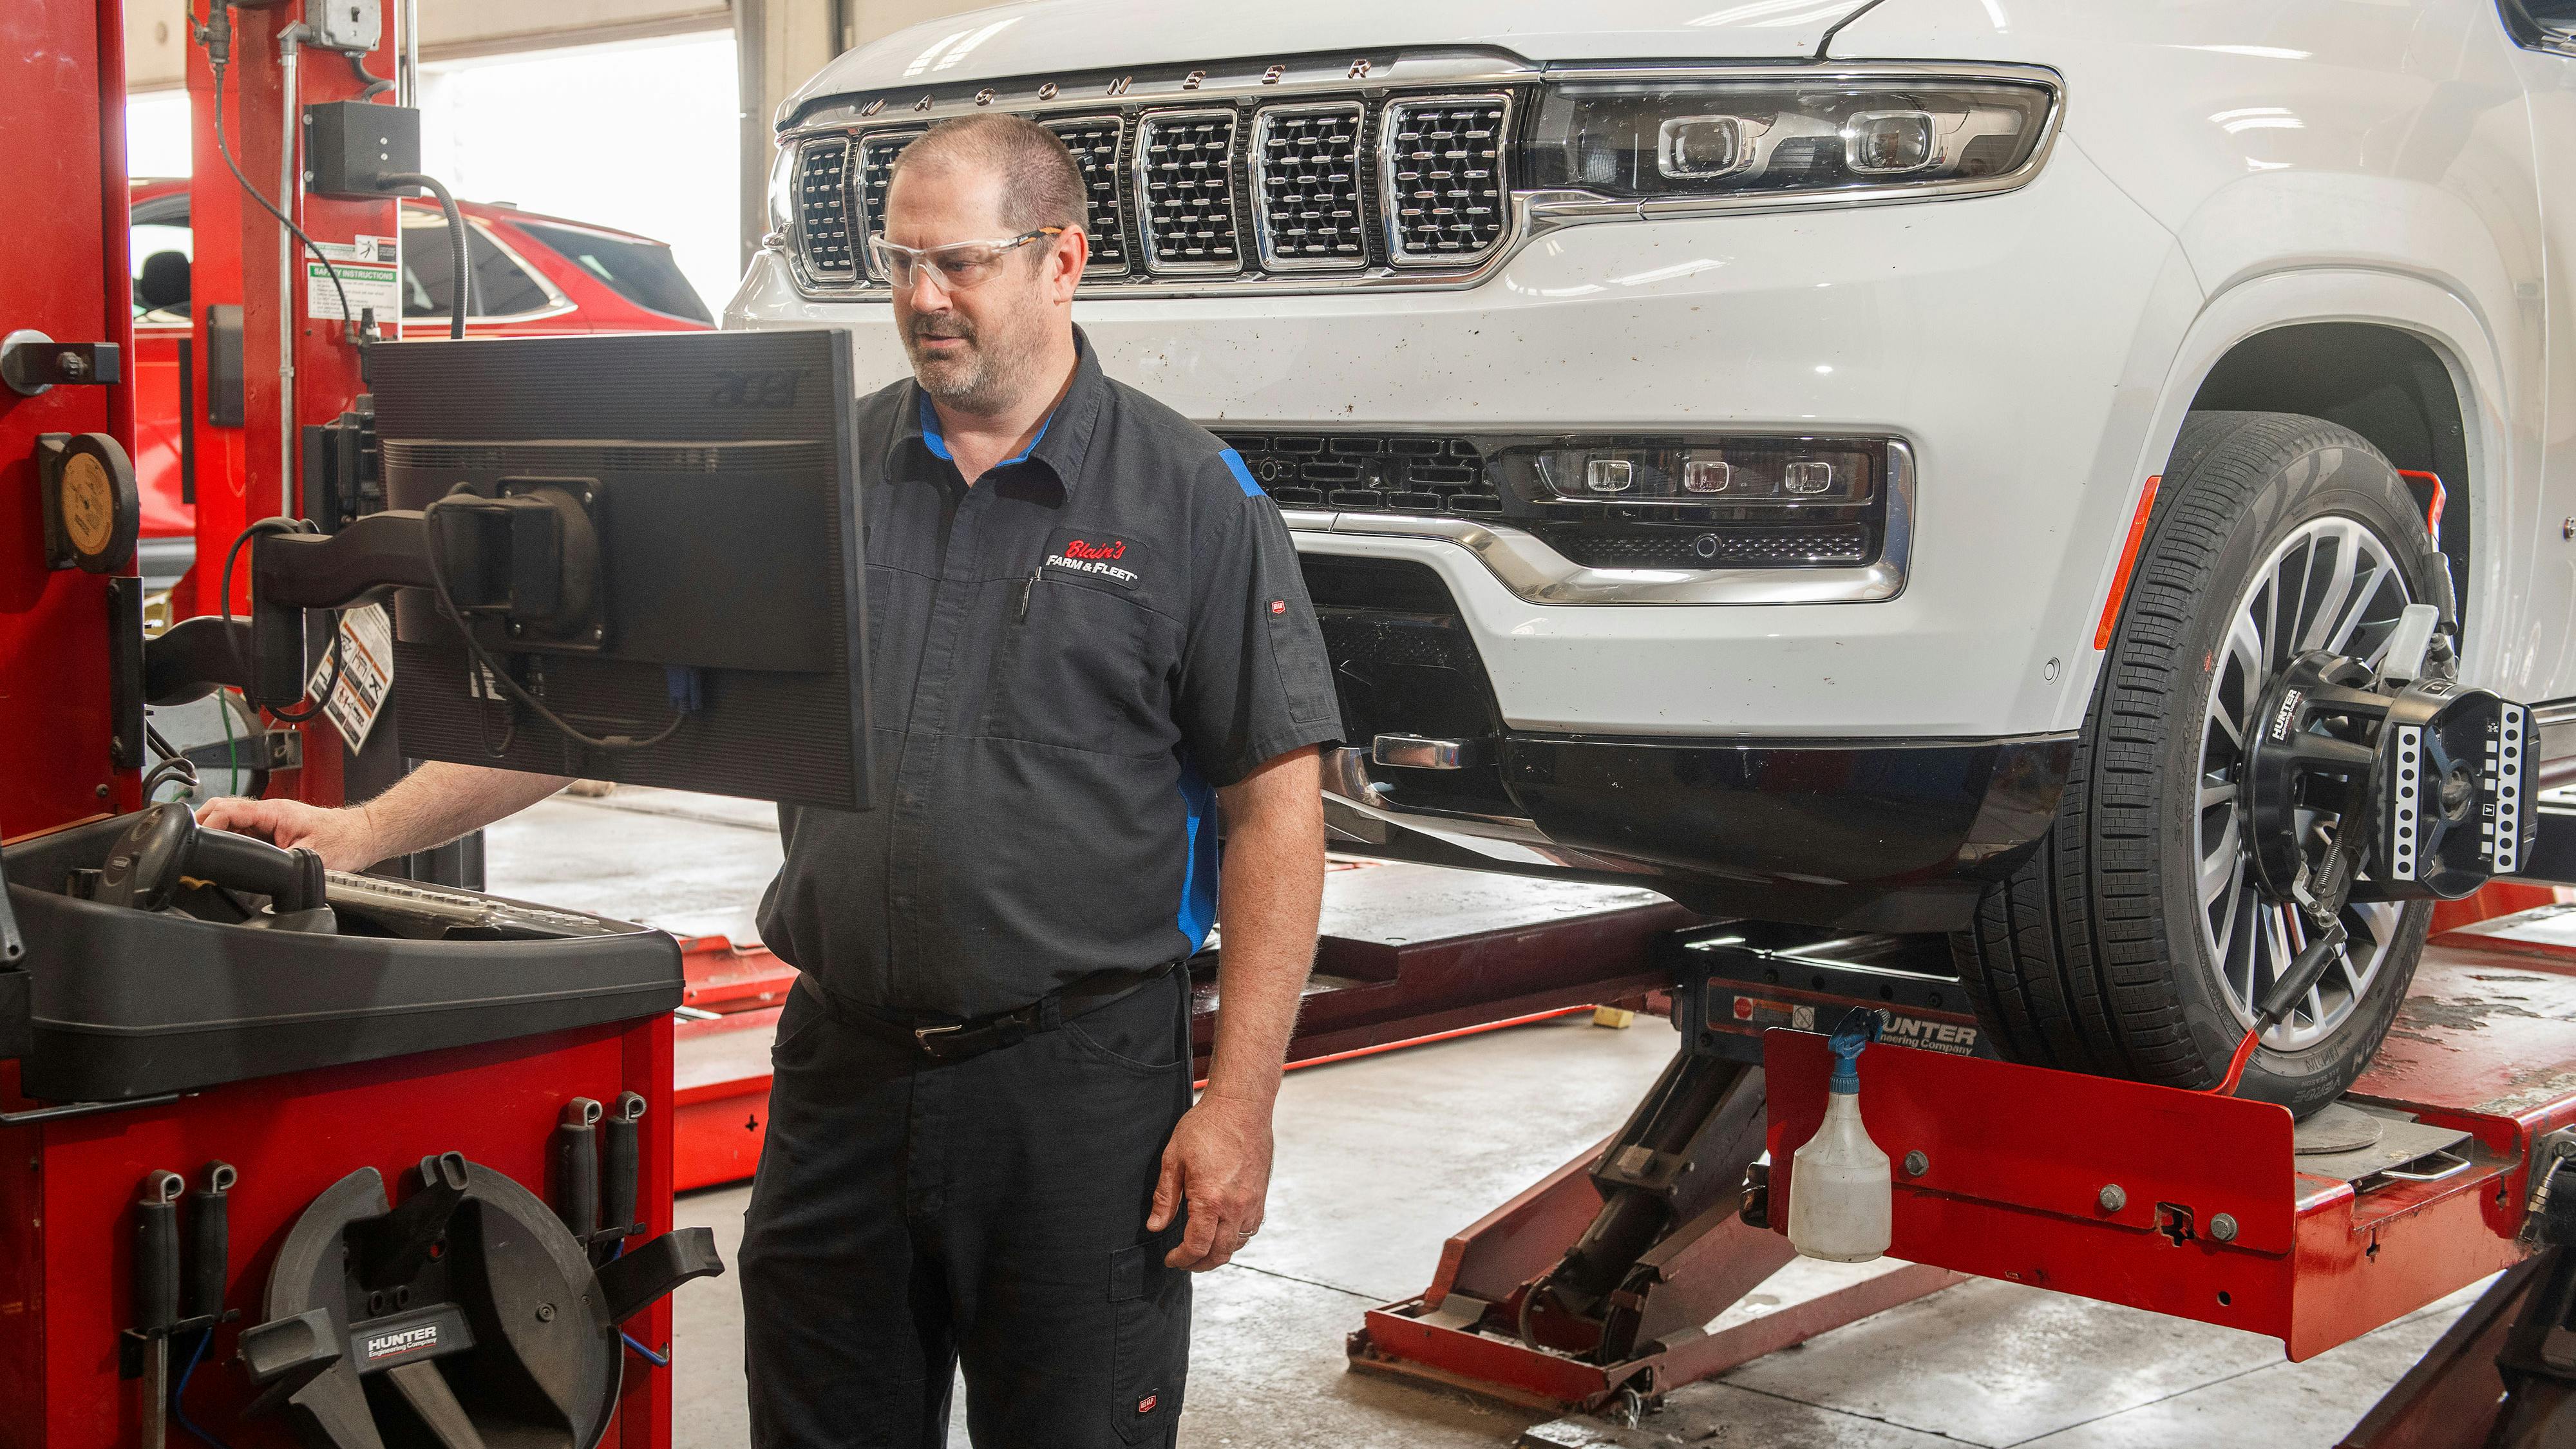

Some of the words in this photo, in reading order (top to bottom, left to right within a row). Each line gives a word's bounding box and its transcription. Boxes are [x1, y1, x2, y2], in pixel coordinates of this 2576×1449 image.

[861, 59, 1372, 116] WAGONEER
[710, 370, 811, 408] acer
[1065, 539, 1126, 560] Blain's
[1045, 555, 1084, 571] FARM
[1082, 562, 1093, 572] &
[2272, 689, 2297, 739] HUNTER
[1882, 1017, 1977, 1045] UNTER
[1880, 1034, 1919, 1048] neering
[1921, 1039, 1973, 1056] Company
[368, 1326, 437, 1351] HUNTER
[368, 1345, 406, 1358] Engineering
[406, 1338, 437, 1349] Company
